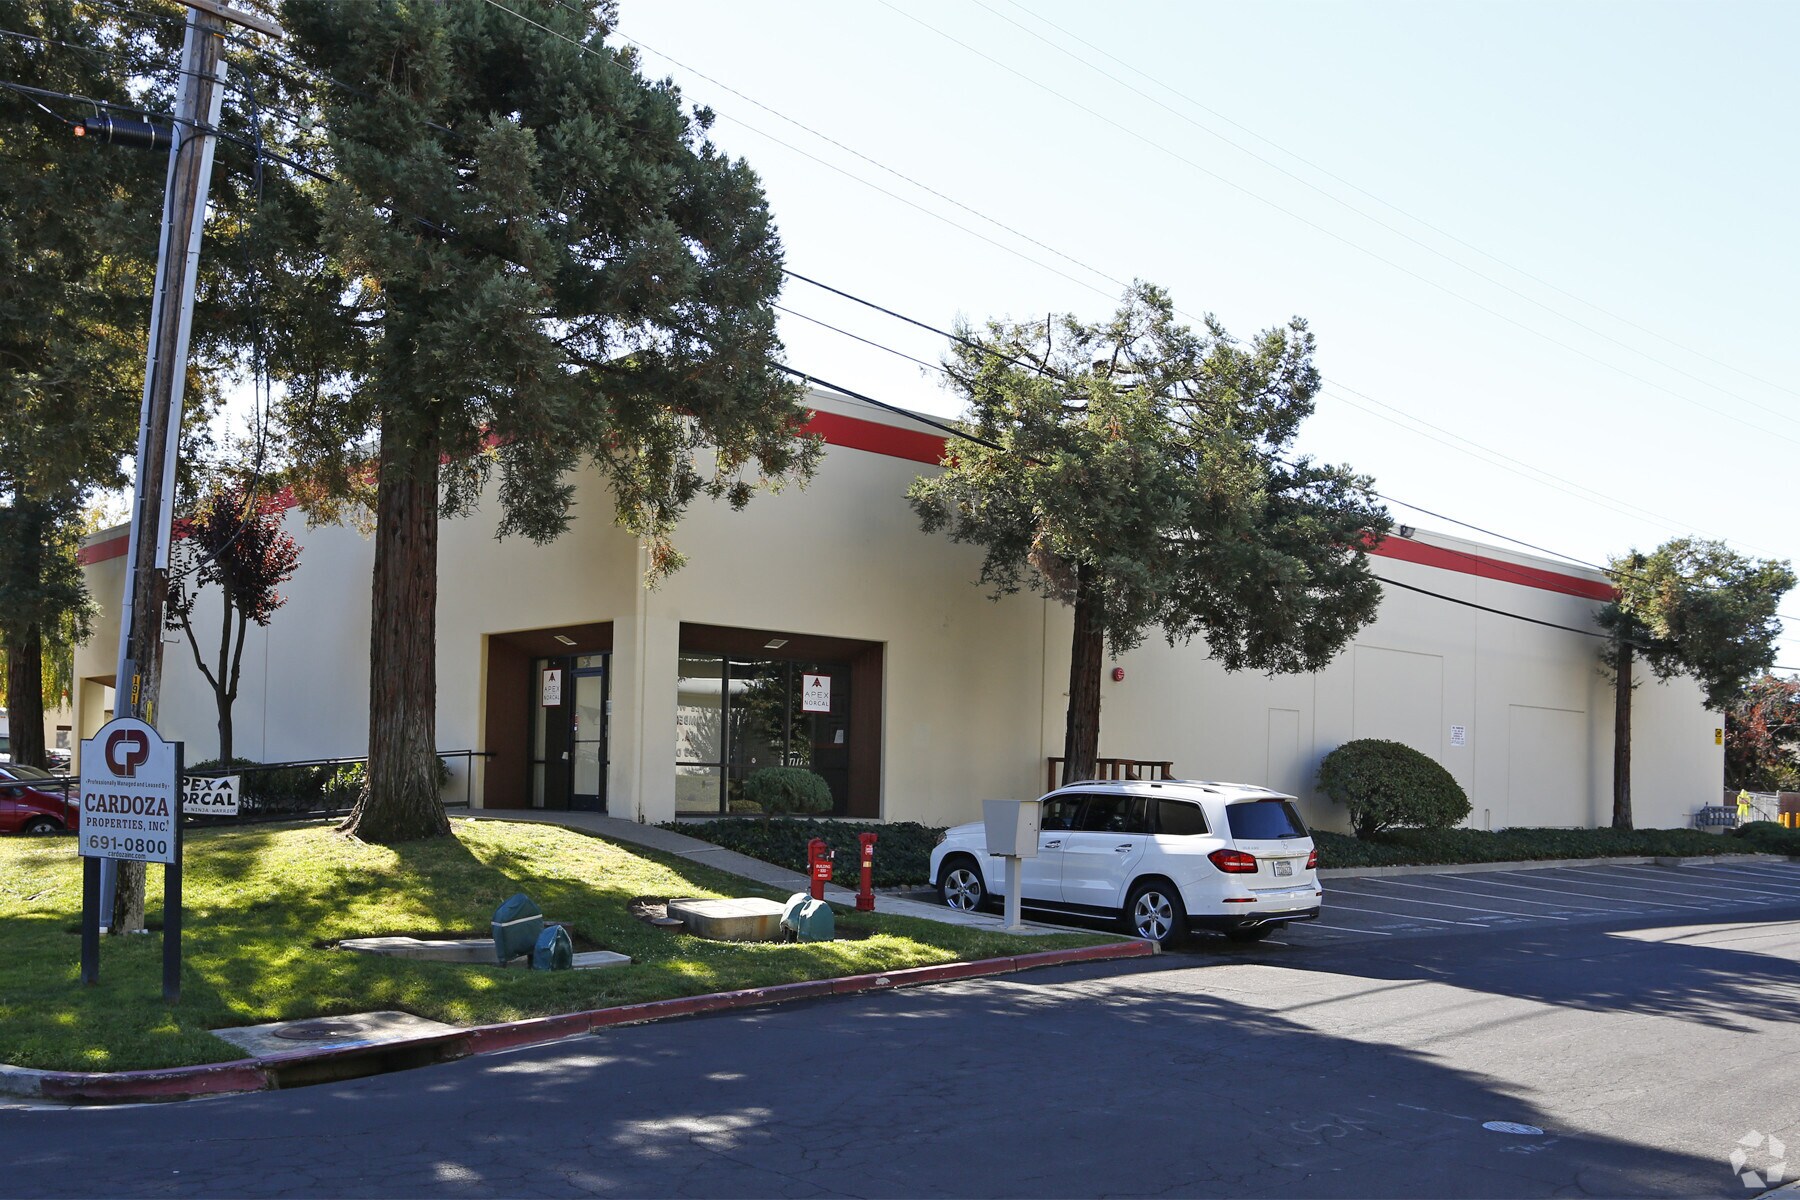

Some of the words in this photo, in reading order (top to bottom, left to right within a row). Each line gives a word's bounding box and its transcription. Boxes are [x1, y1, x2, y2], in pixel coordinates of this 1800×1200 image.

[804, 691, 829, 699] APEX
[87, 779, 116, 787] Professionally
[117, 780, 136, 788] Managed
[162, 782, 168, 790] By
[85, 793, 169, 816] CARDOZA
[86, 817, 146, 832] PROPERTIES,
[148, 821, 168, 832] INC.
[90, 835, 167, 854] 691-0800
[108, 850, 146, 859] cardozainc.com
